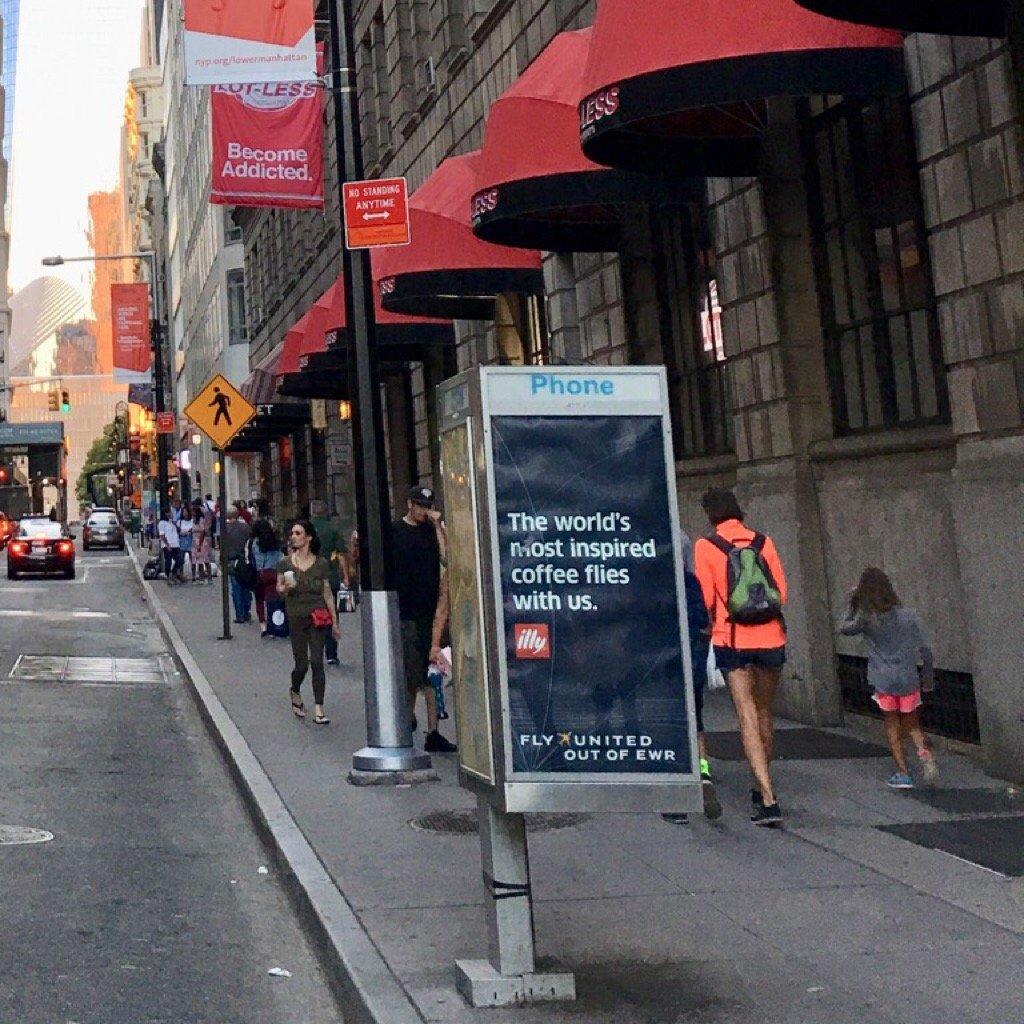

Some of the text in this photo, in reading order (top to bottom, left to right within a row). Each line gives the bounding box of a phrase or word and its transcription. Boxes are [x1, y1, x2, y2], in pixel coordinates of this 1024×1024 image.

[195, 53, 308, 67] nyp.org/lowermanhattan
[227, 142, 308, 162] Become
[221, 160, 313, 181] Addicted.
[348, 184, 401, 198] NO STANDING
[356, 198, 395, 211] ANYTIME
[531, 373, 614, 396] Phone
[507, 512, 632, 532] The world's
[510, 538, 657, 561] most inspired
[511, 566, 631, 585] coffee flies
[513, 592, 598, 611] with us.
[517, 629, 547, 654] illy
[520, 735, 653, 747] FLY UNITED
[564, 749, 676, 761] OUT OF EWR
